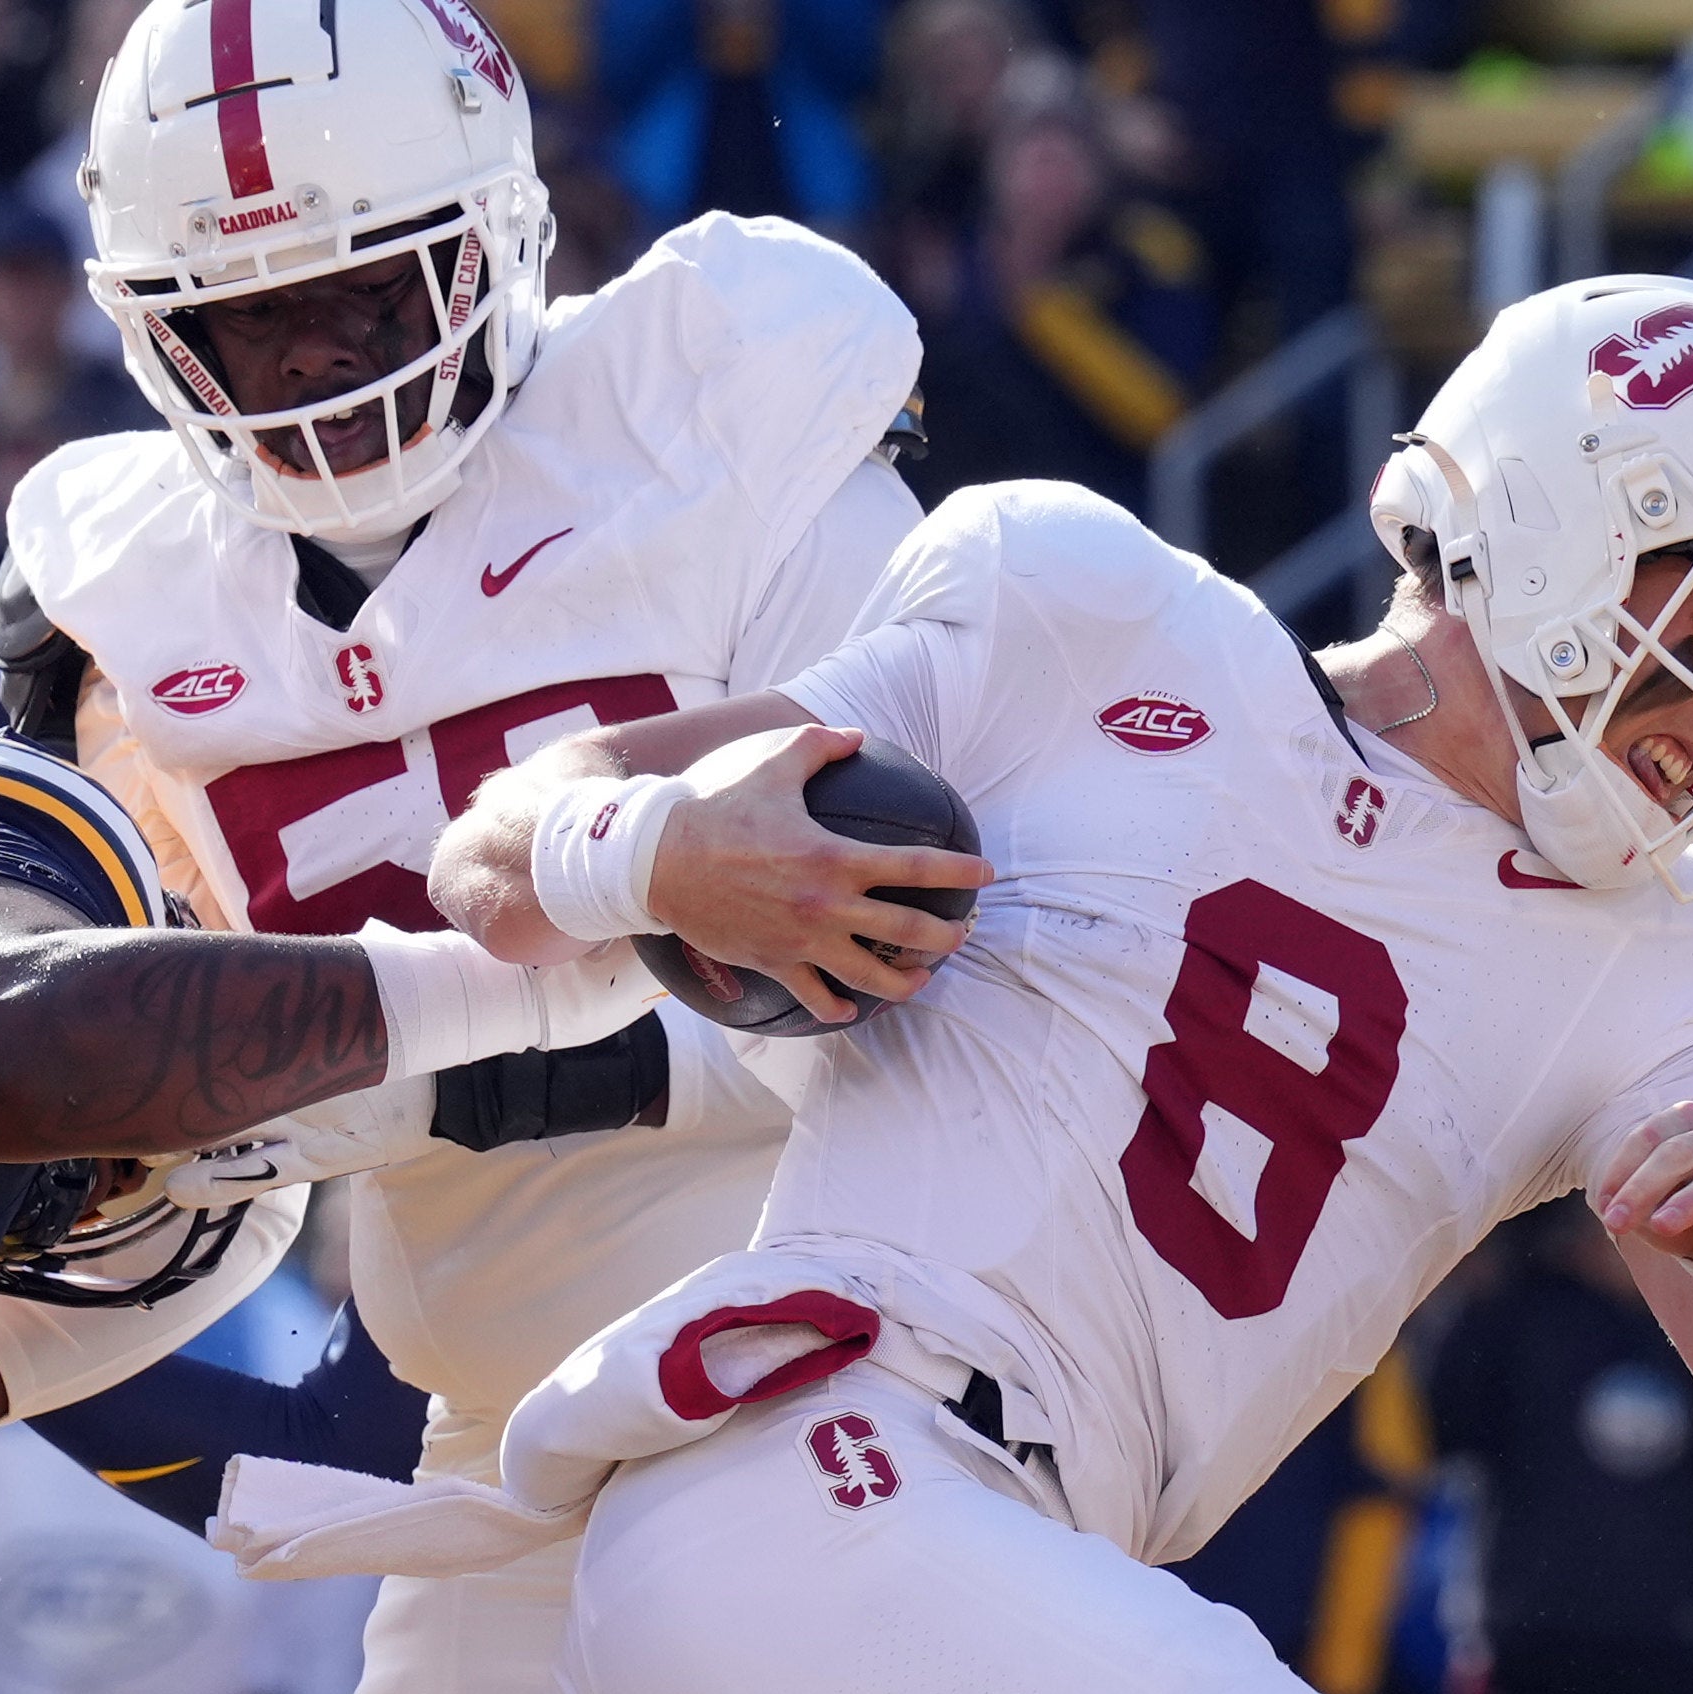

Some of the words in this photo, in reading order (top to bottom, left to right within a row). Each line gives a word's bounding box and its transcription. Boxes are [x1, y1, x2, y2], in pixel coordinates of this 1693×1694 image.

[218, 201, 297, 235] CARDINAL
[439, 294, 472, 381] STAORD
[162, 667, 237, 697] ACC
[1114, 706, 1201, 735] ACC
[1119, 877, 1409, 1320] 8
[805, 1411, 901, 1511] S
